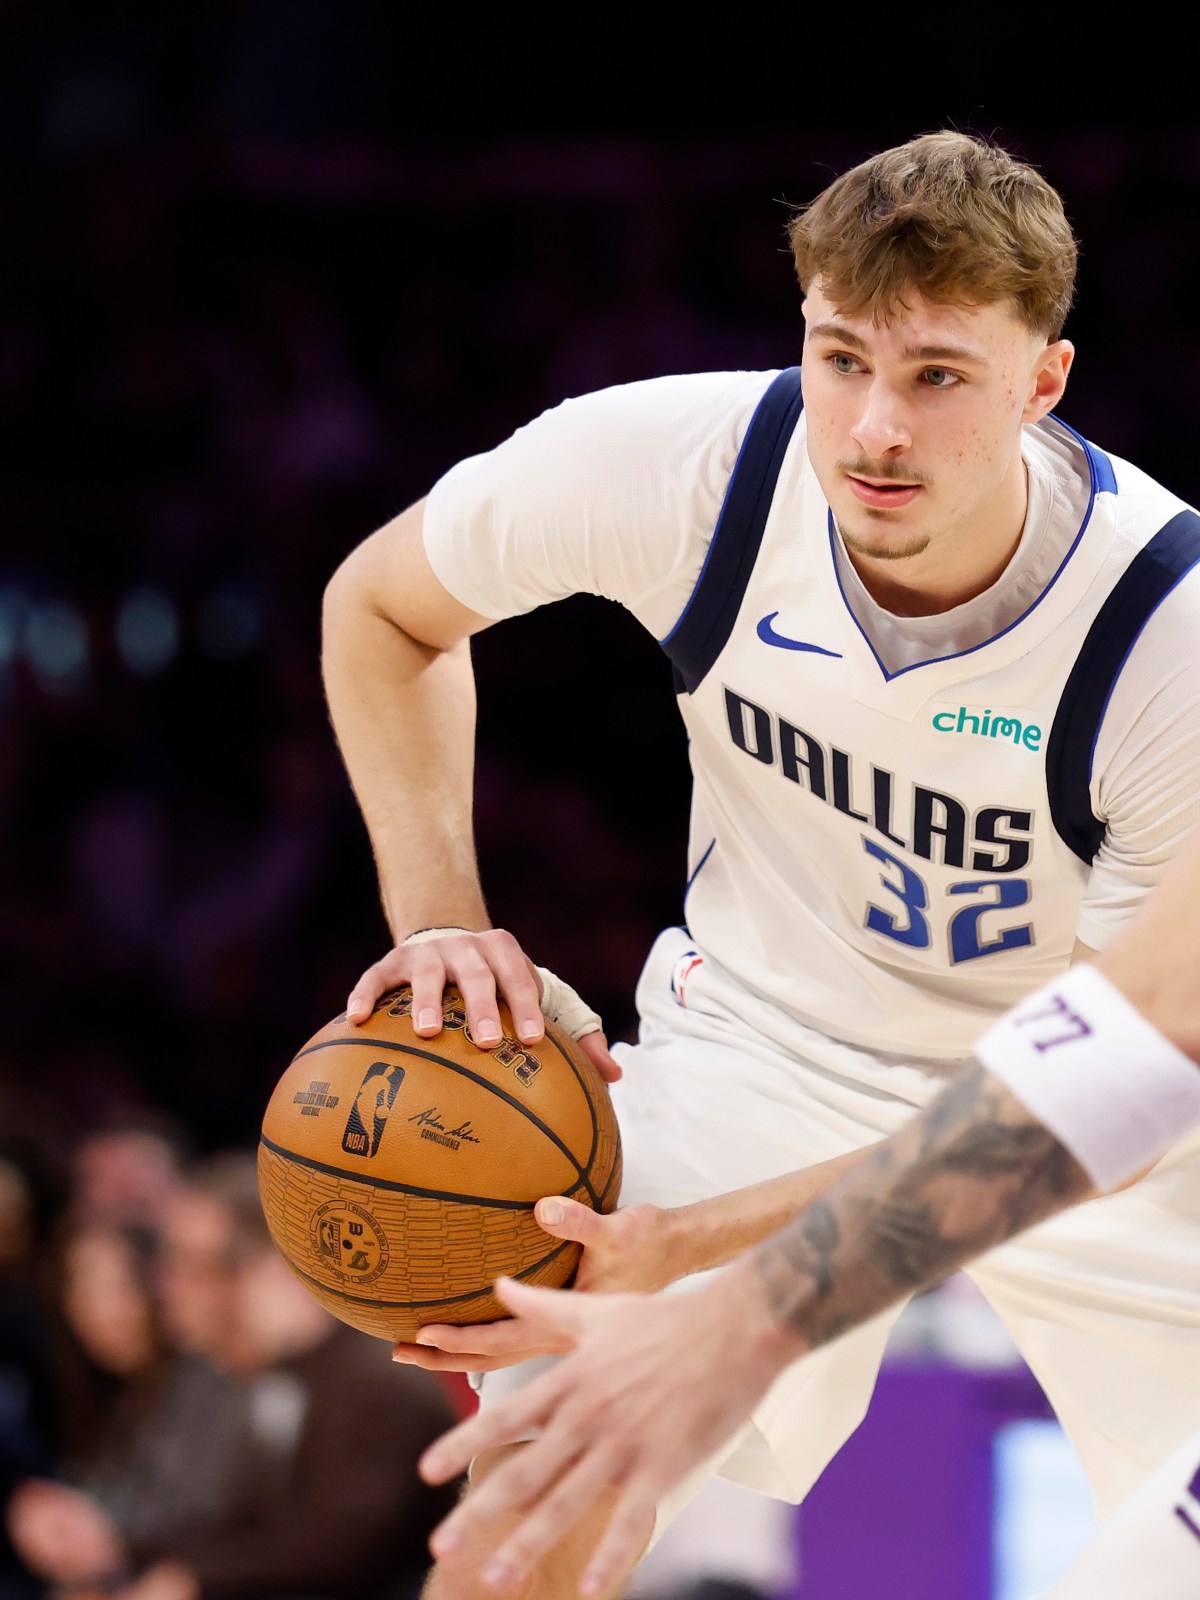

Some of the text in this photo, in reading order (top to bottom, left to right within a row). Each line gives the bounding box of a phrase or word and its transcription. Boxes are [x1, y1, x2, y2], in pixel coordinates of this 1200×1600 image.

[932, 706, 1042, 752] chime
[721, 682, 1037, 875] DALLAS
[860, 833, 1036, 966] 32
[1012, 994, 1094, 1055] 77
[346, 1132, 366, 1151] NBA
